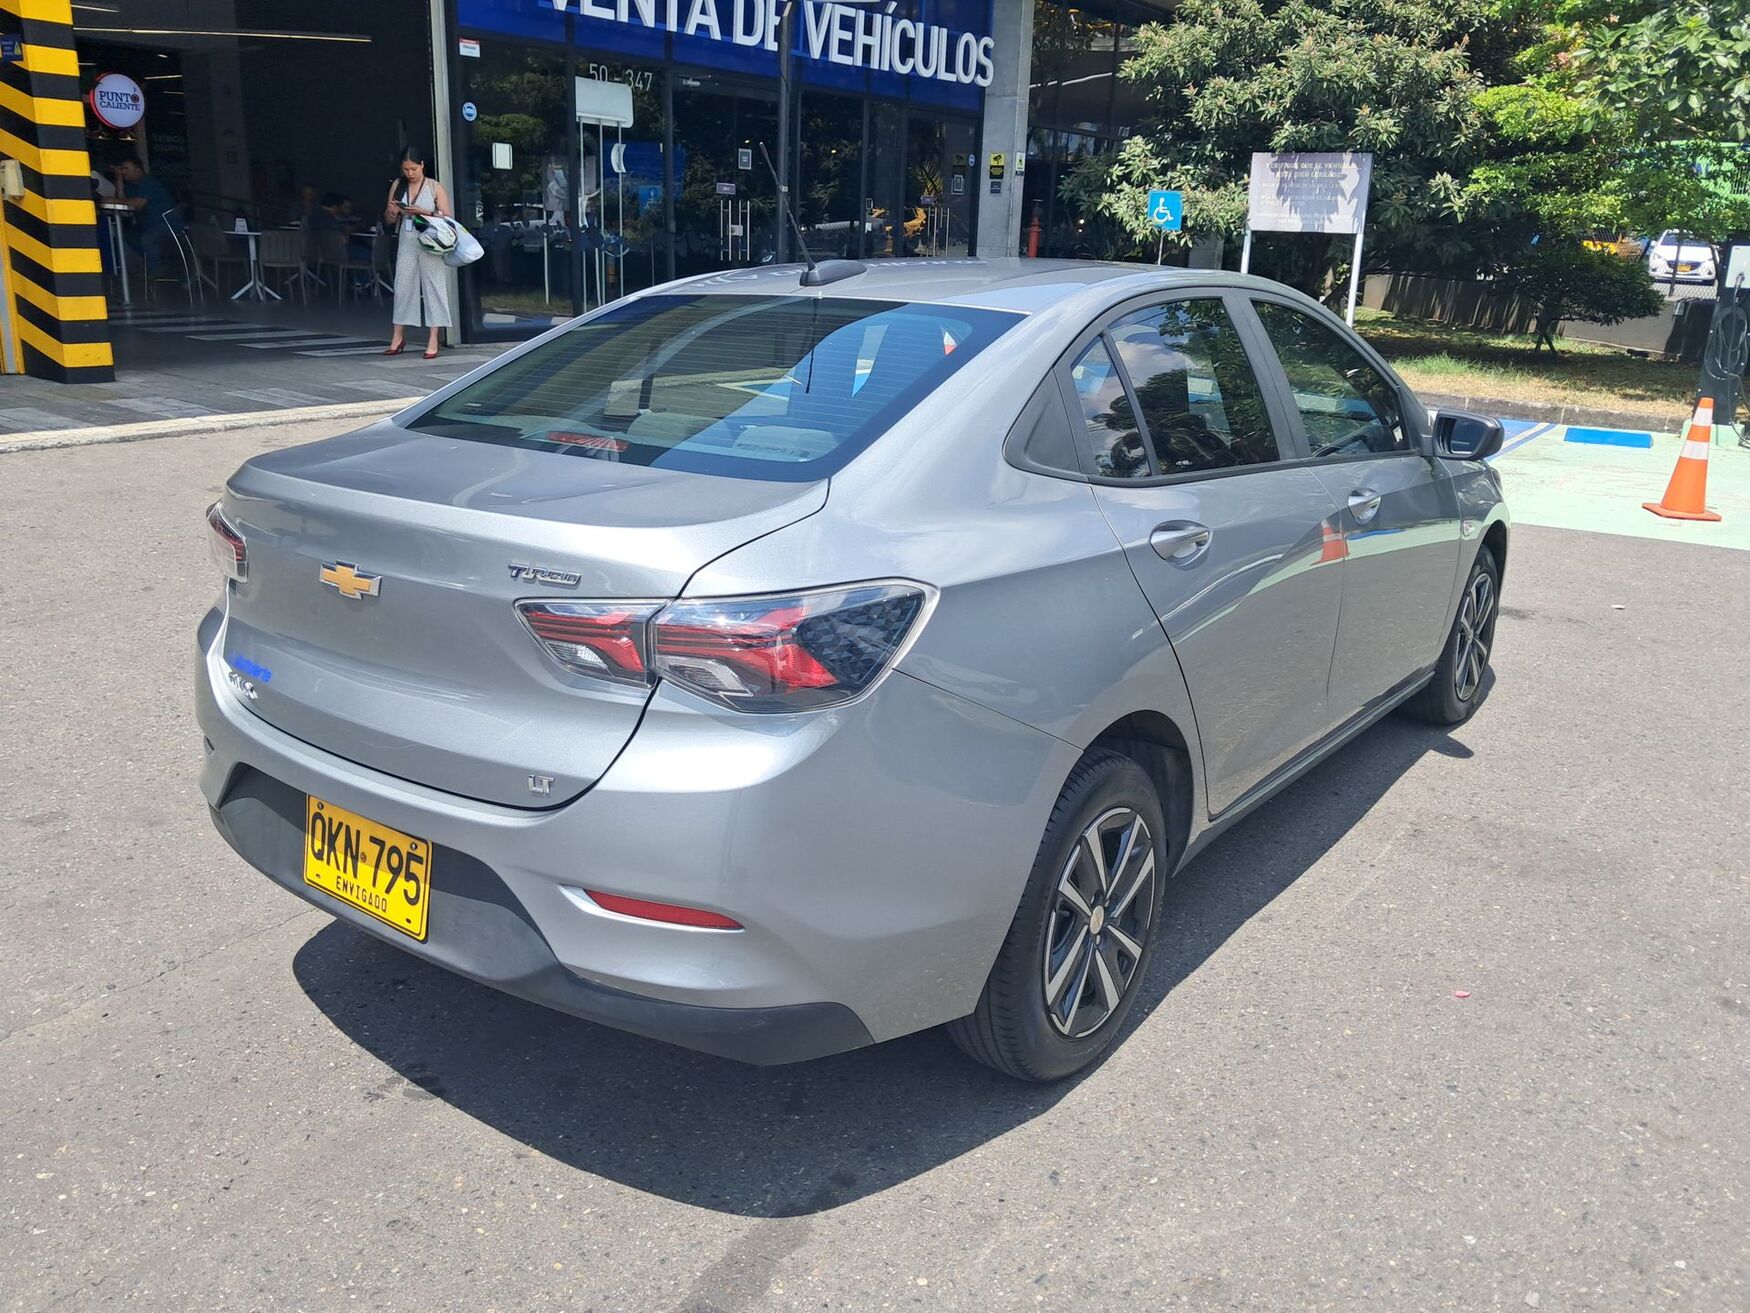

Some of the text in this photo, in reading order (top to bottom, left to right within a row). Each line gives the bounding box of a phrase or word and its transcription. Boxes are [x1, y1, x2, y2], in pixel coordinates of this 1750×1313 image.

[804, 1, 994, 87] VEHÍCULOS
[589, 63, 608, 83] 50
[625, 69, 653, 92] 347
[98, 90, 140, 104] PUNTO
[99, 101, 141, 111] CALIENTE
[508, 563, 581, 586] TURBO
[528, 774, 554, 794] LT
[368, 834, 424, 906] 795
[335, 875, 389, 914] ENVIGADO
